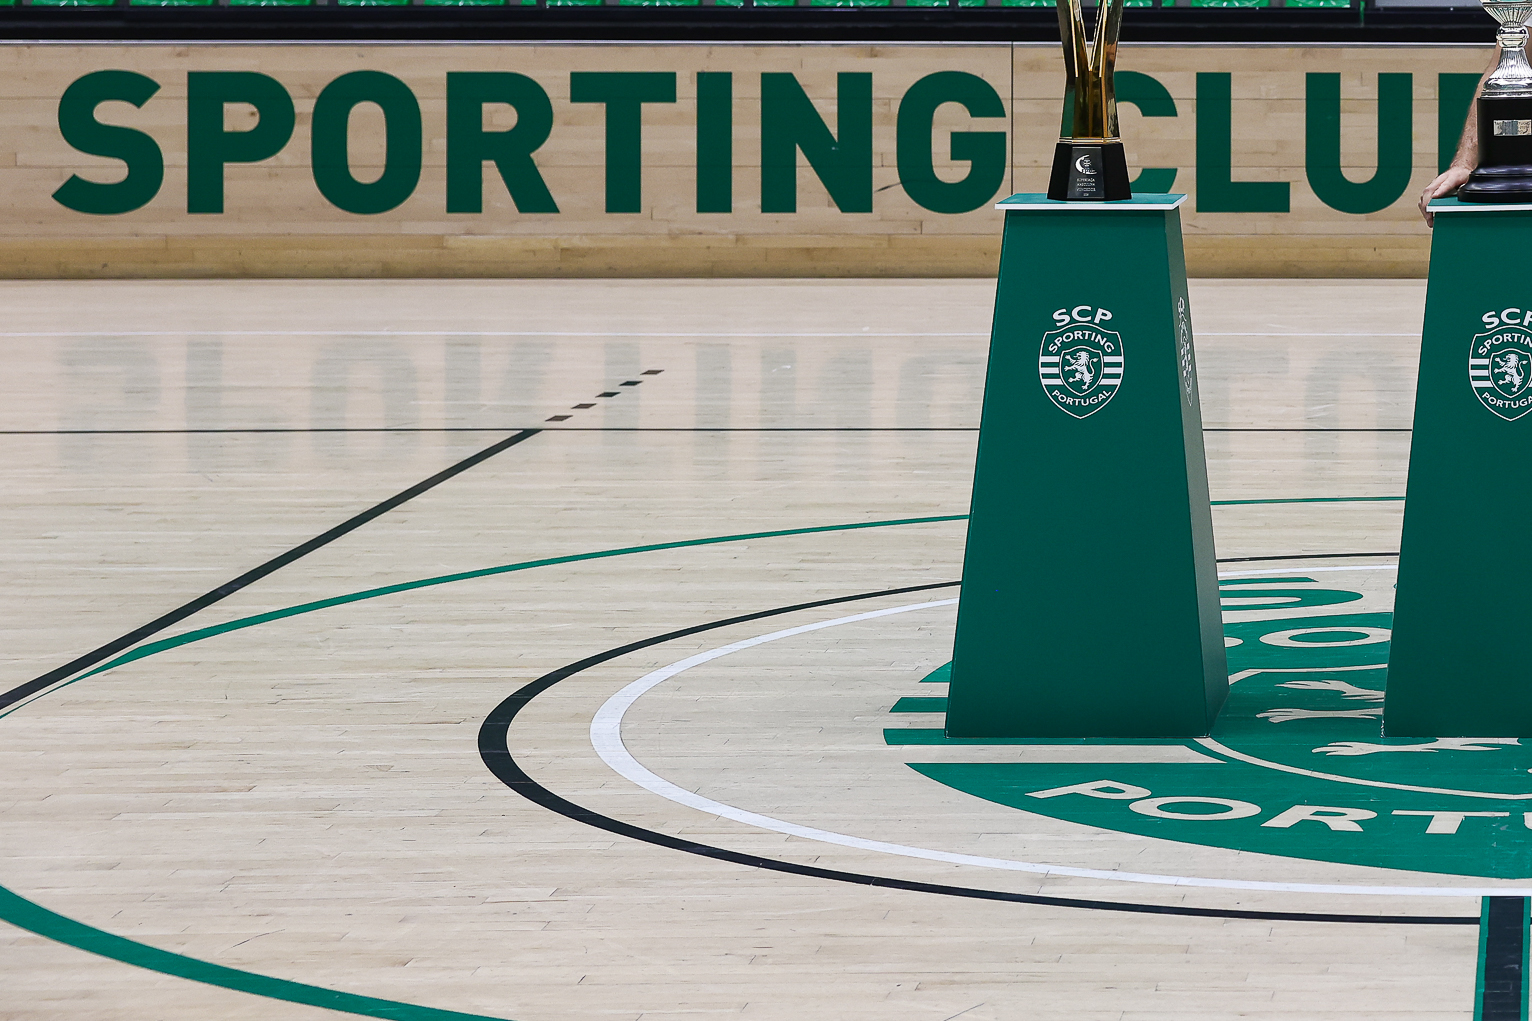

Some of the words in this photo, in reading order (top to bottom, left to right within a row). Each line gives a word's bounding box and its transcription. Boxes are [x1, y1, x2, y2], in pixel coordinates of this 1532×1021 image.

[52, 69, 1007, 214] SPORTING
[1052, 305, 1113, 326] SCP
[1048, 330, 1115, 354] SPORTING
[1051, 389, 1112, 406] PORTUGAL
